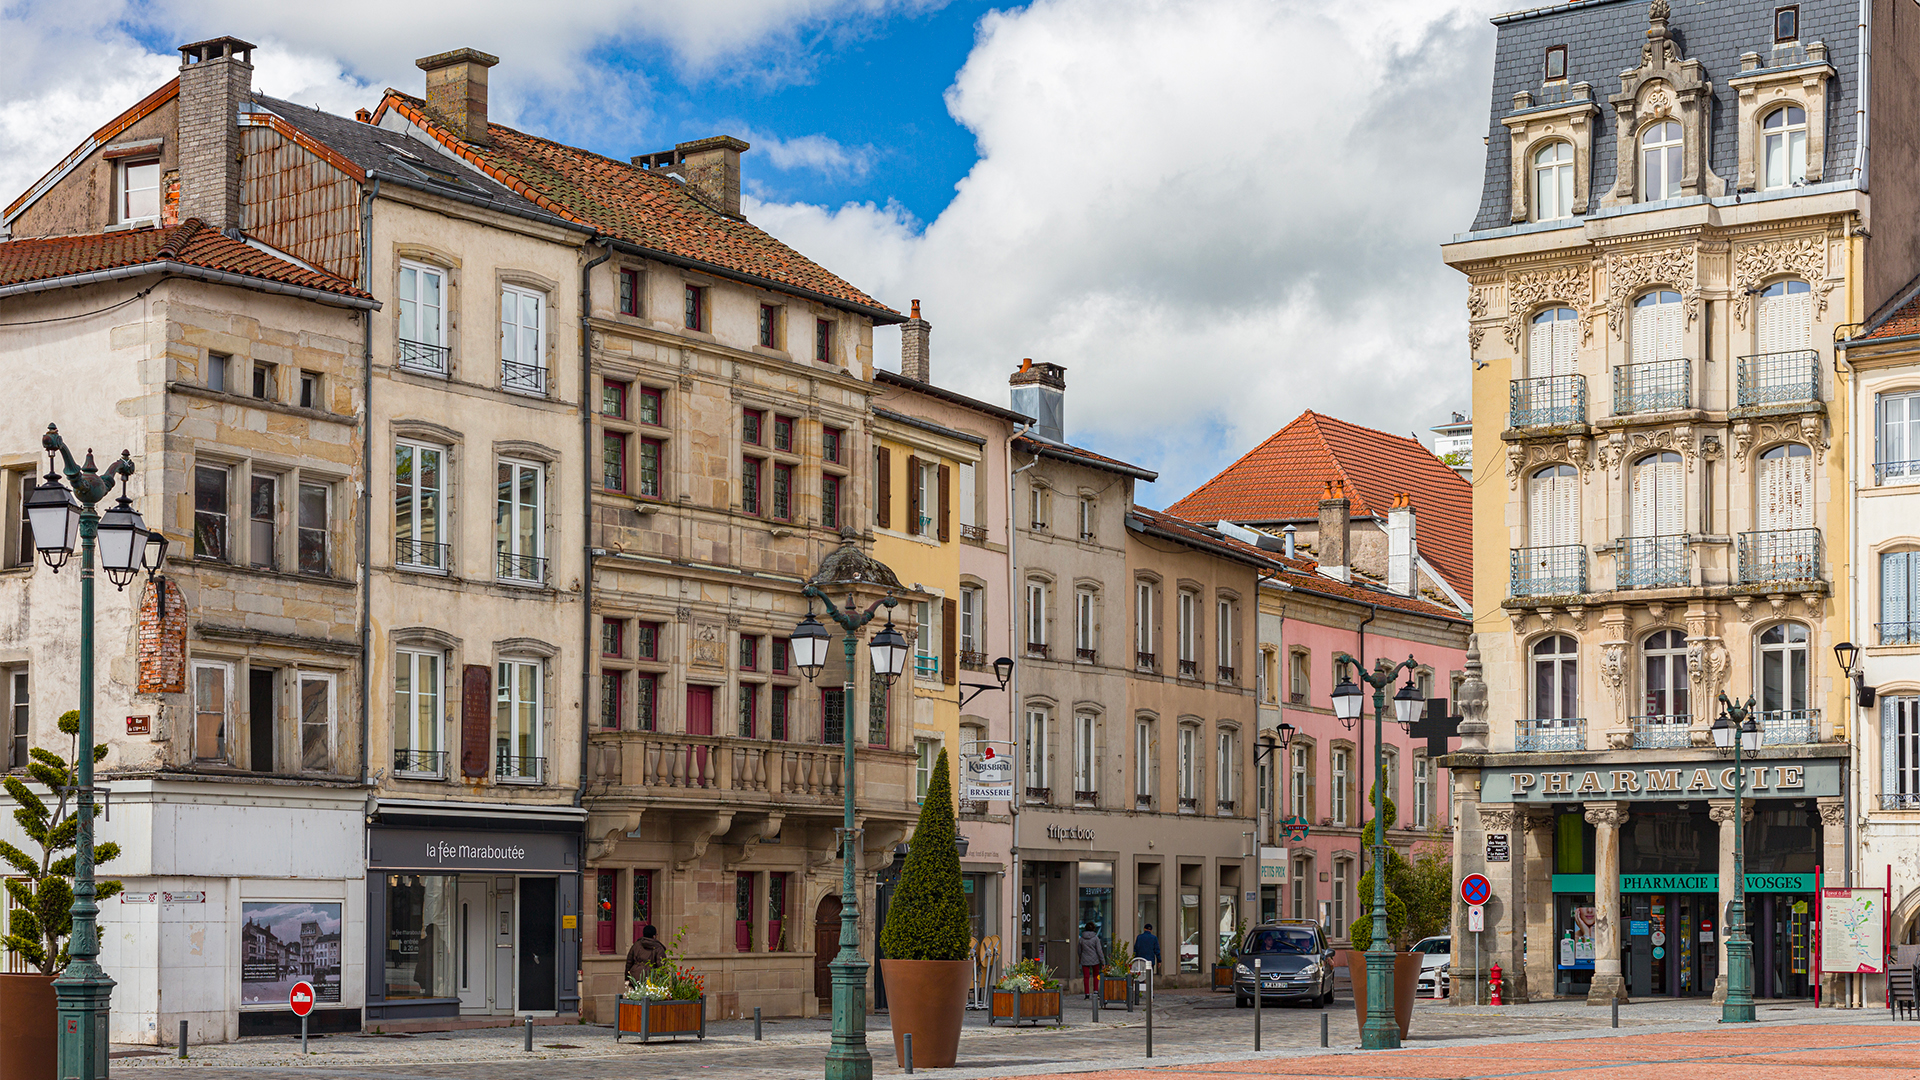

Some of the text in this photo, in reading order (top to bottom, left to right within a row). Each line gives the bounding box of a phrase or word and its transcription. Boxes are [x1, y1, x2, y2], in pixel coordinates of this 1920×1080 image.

[1509, 765, 1804, 795] PHARMACIE
[970, 788, 1011, 797] BRASSERIE
[1048, 823, 1067, 843] frip
[1077, 825, 1096, 840] broc
[426, 840, 525, 864] la fée maraboutée
[1275, 865, 1286, 878] PRIX
[1623, 876, 1708, 889] PHARMACIE
[1745, 876, 1802, 889] VOSGES
